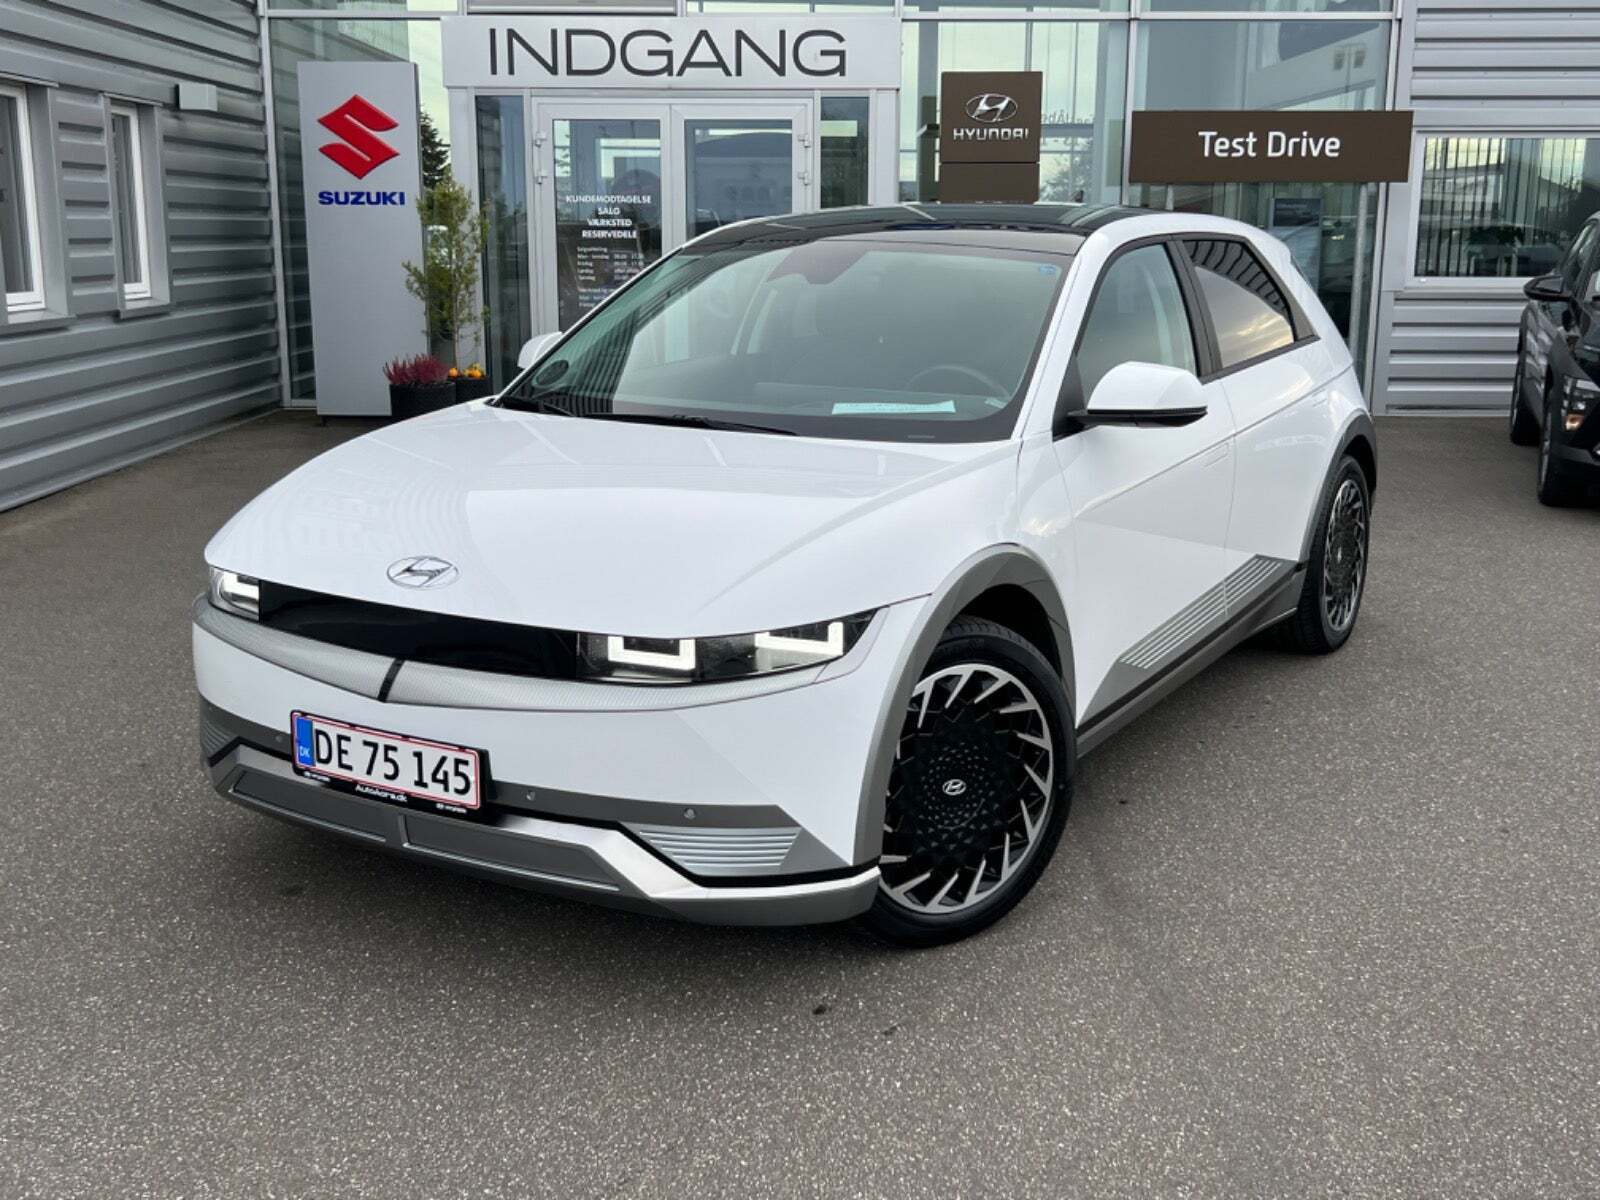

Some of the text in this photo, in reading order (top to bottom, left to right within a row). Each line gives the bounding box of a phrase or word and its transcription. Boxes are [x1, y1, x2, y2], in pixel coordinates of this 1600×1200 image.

[488, 28, 847, 77] INDGANG
[953, 127, 1029, 141] HYUNDAI
[1198, 131, 1341, 158] Test Drive
[318, 191, 406, 206] SUZUKI
[566, 195, 651, 204] KUNDEMODTAGELSE
[598, 207, 621, 215] SALG
[587, 219, 632, 227] VÆRKSTED
[582, 230, 637, 238] RESERVEDELE
[299, 745, 311, 758] DK
[315, 728, 471, 795] DE 75 145
